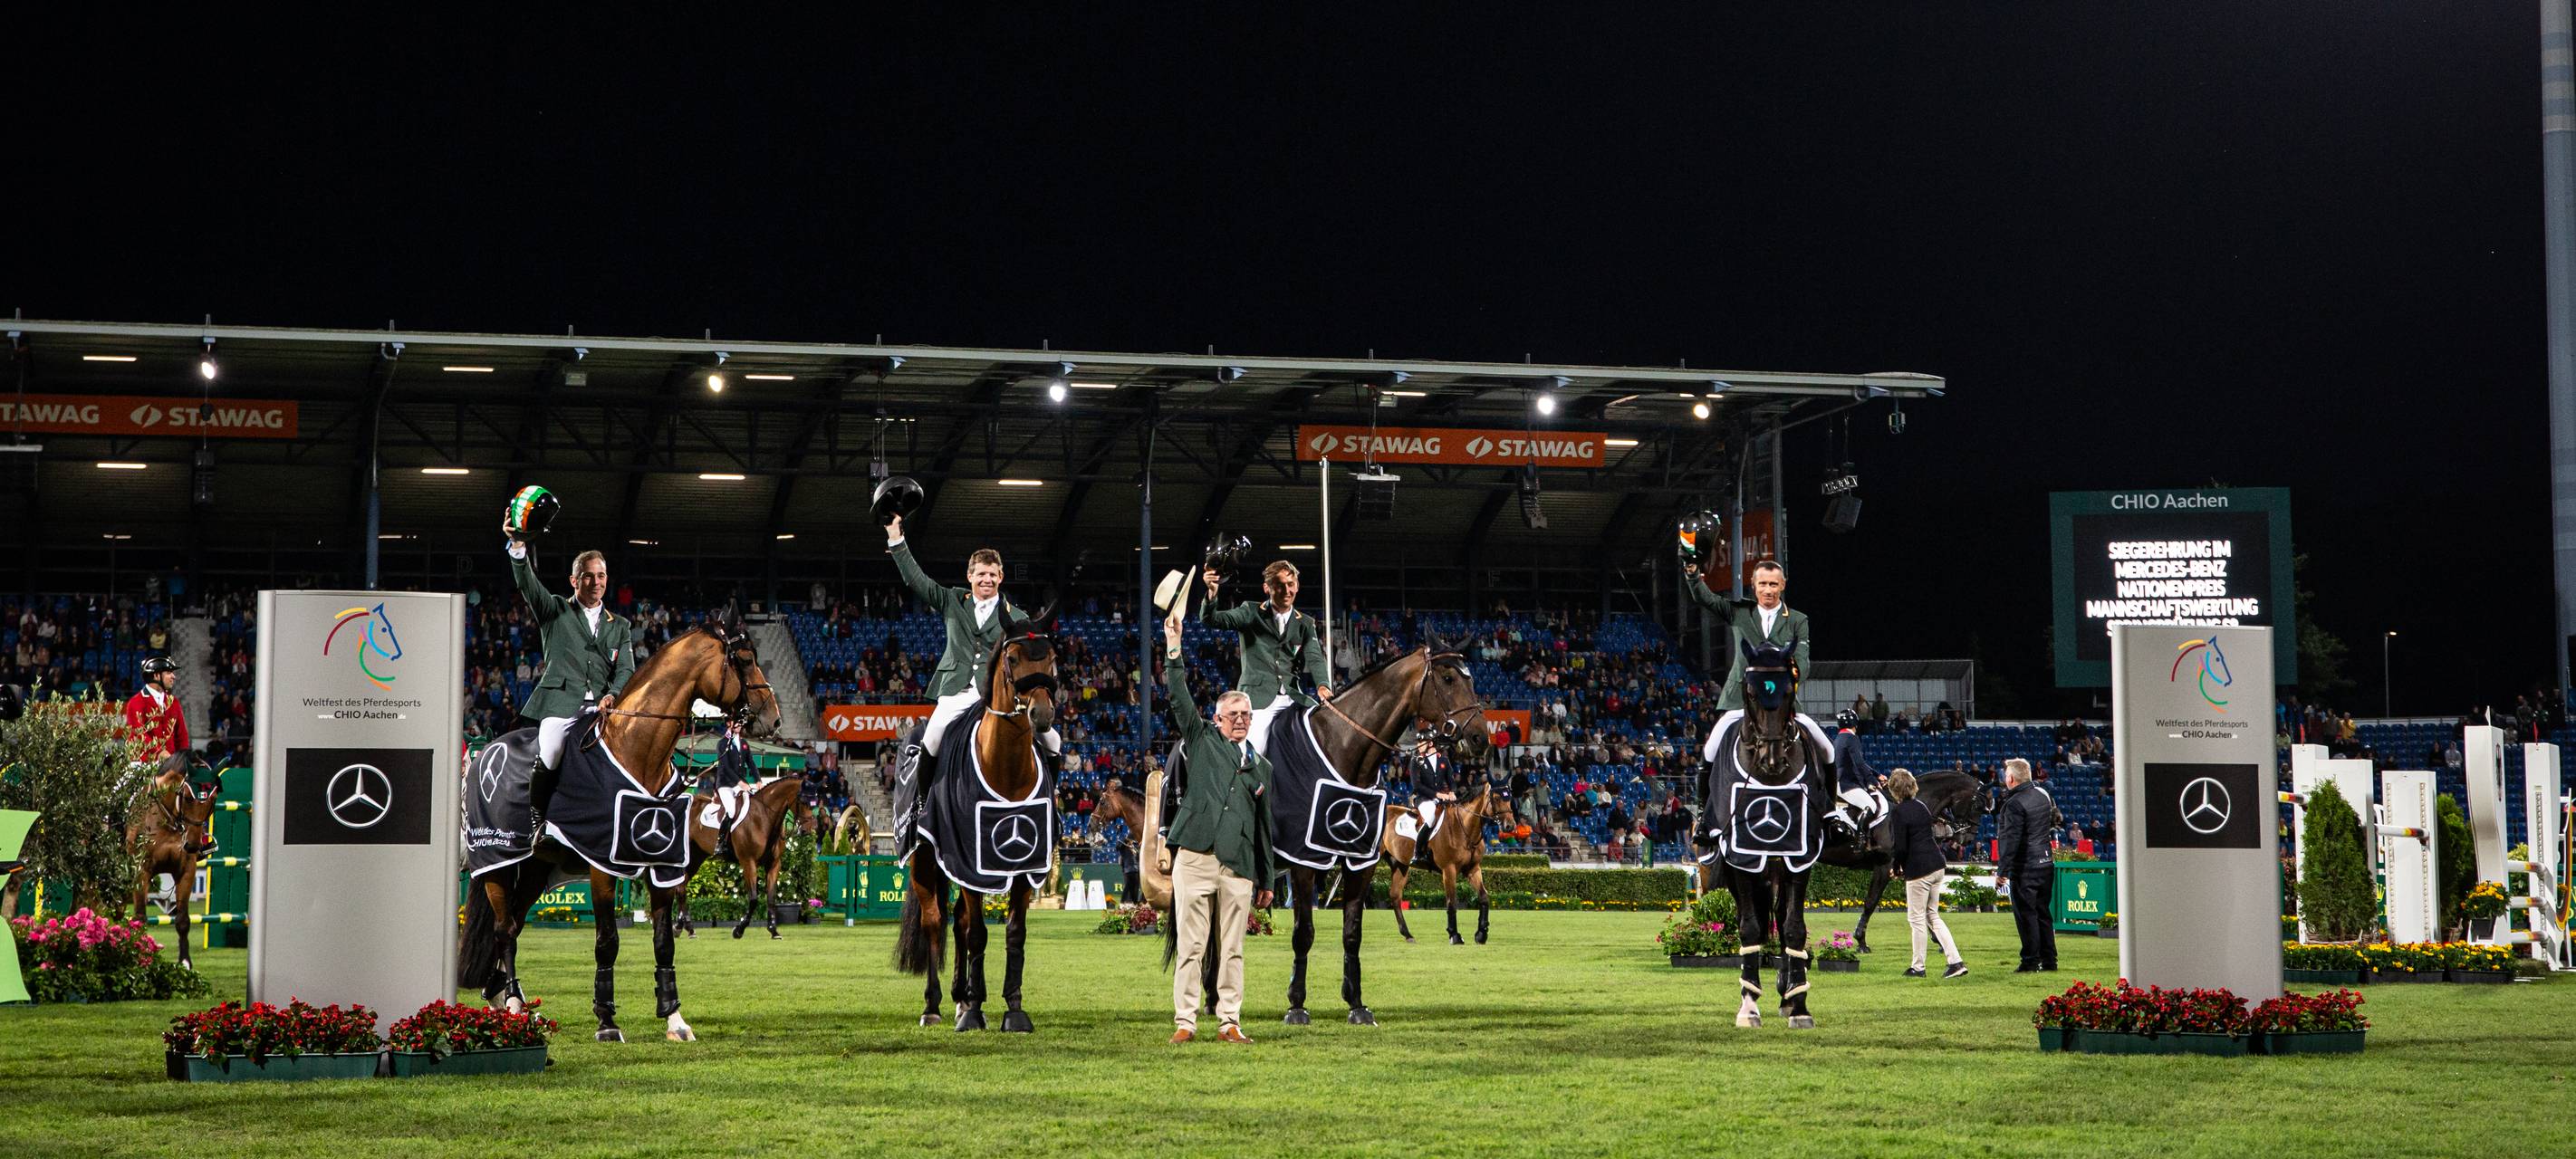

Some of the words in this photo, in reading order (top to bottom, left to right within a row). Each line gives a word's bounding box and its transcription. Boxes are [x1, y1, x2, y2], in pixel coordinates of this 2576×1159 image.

[1342, 435, 1441, 455] STAWAG
[1497, 438, 1594, 459] STAWAG
[2110, 493, 2159, 510] CHIO
[2163, 493, 2228, 509] Aachen
[2108, 541, 2211, 560] SIEGEREHRUNG
[2212, 540, 2231, 558] IM
[2115, 560, 2227, 579] MERCEDES-BENZ
[2117, 580, 2226, 599] NATIONENPREIS
[2086, 598, 2259, 618] MANNSCHAFTSWERTUNG
[303, 698, 343, 707] Weltfest
[344, 698, 361, 707] des
[363, 698, 421, 708] Pferdesports
[2156, 719, 2189, 728] Weltfest
[2190, 720, 2204, 728] des
[2205, 720, 2248, 729] Pferdesports
[879, 890, 906, 902] ROLE
[2068, 900, 2099, 913] ROLEX
